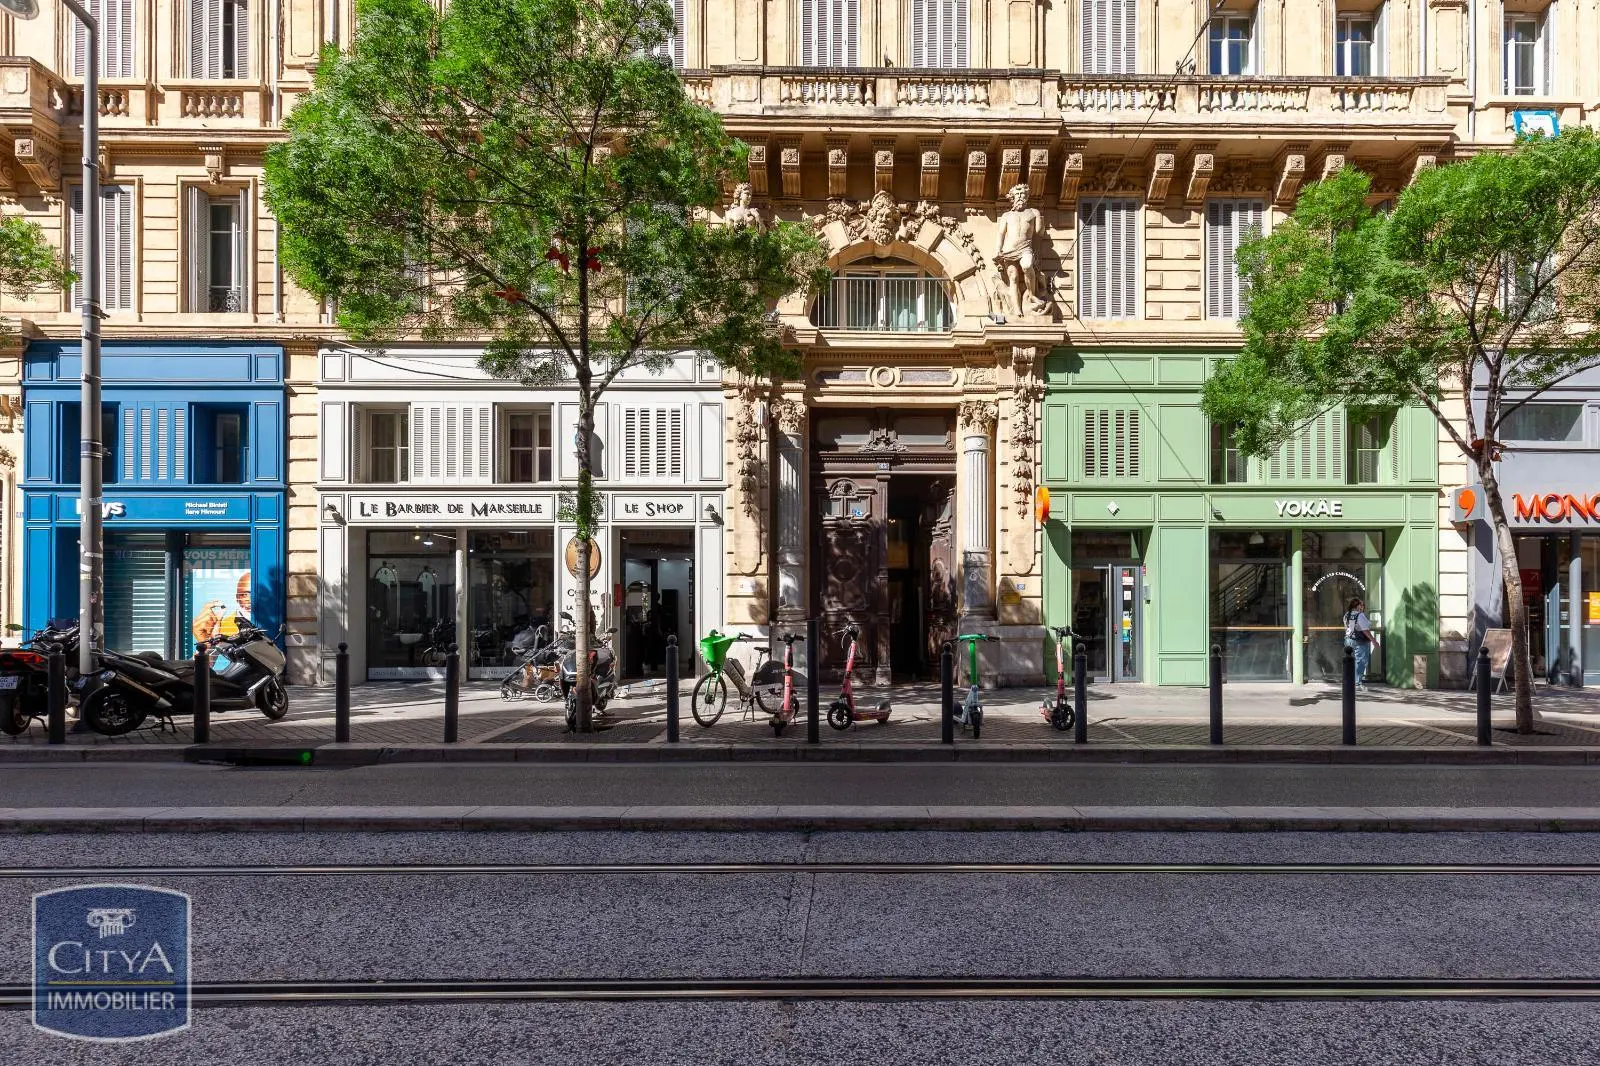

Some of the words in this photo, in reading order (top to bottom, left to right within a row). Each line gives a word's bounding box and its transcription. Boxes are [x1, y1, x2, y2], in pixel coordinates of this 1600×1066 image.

[76, 499, 124, 518] ys
[359, 501, 379, 517] LE
[385, 501, 442, 517] BARBIER
[447, 503, 464, 514] DE
[471, 502, 543, 517] MARSEILLE
[624, 503, 639, 513] LE
[645, 502, 684, 517] SHOP
[184, 550, 216, 560] VOUS
